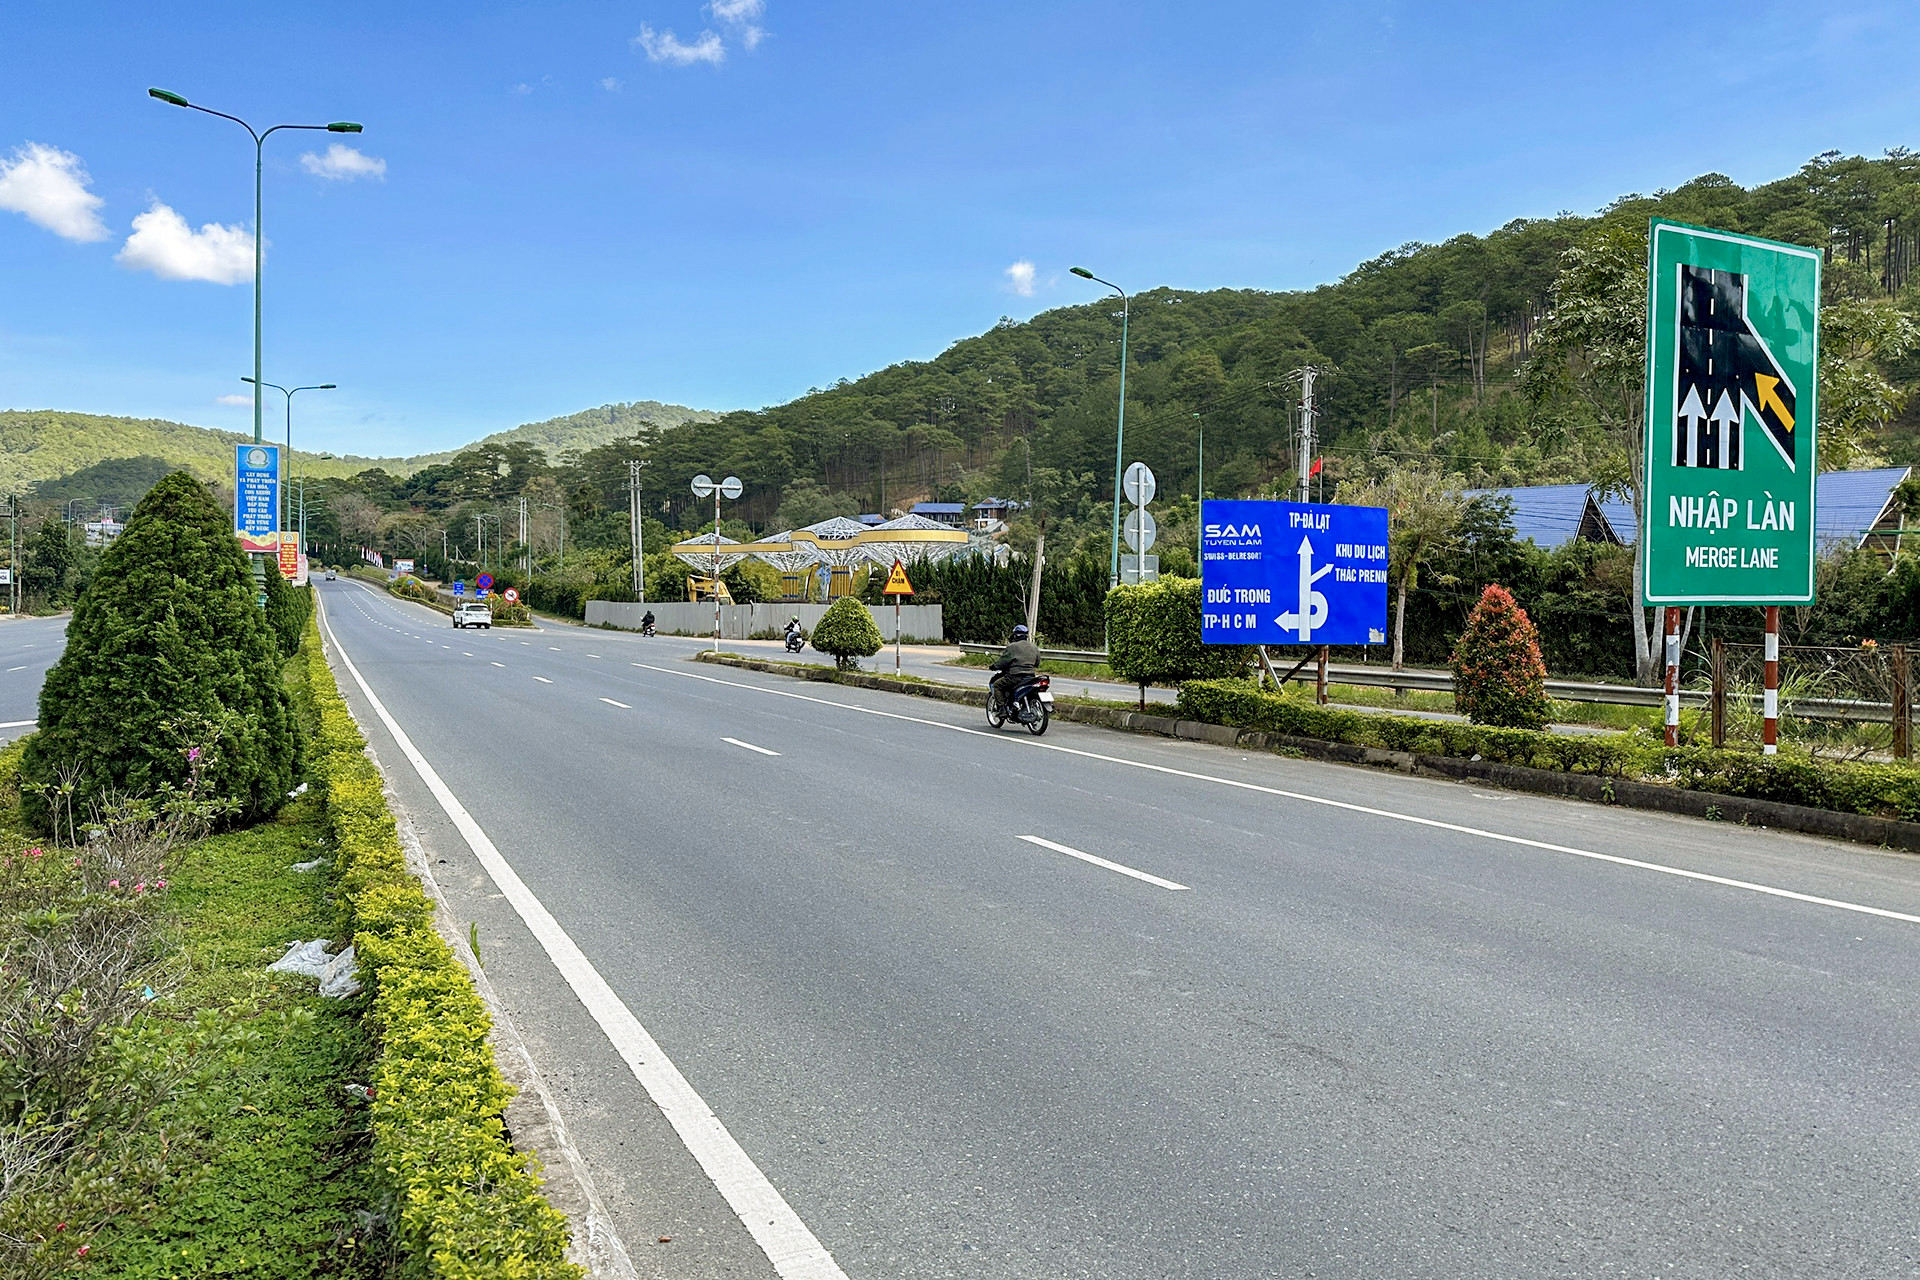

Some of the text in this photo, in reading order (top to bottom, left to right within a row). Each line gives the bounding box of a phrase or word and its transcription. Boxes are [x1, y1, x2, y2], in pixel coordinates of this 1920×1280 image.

[1669, 490, 1795, 534] NHẬP LÀN
[1204, 524, 1262, 538] SAM
[1316, 514, 1330, 533] LẠT
[1336, 544, 1386, 562] KHU DU LỊCH
[1685, 546, 1779, 568] MERGE LANE
[1336, 566, 1387, 583] THÁC PRENN
[1234, 589, 1270, 606] TRỌNG
